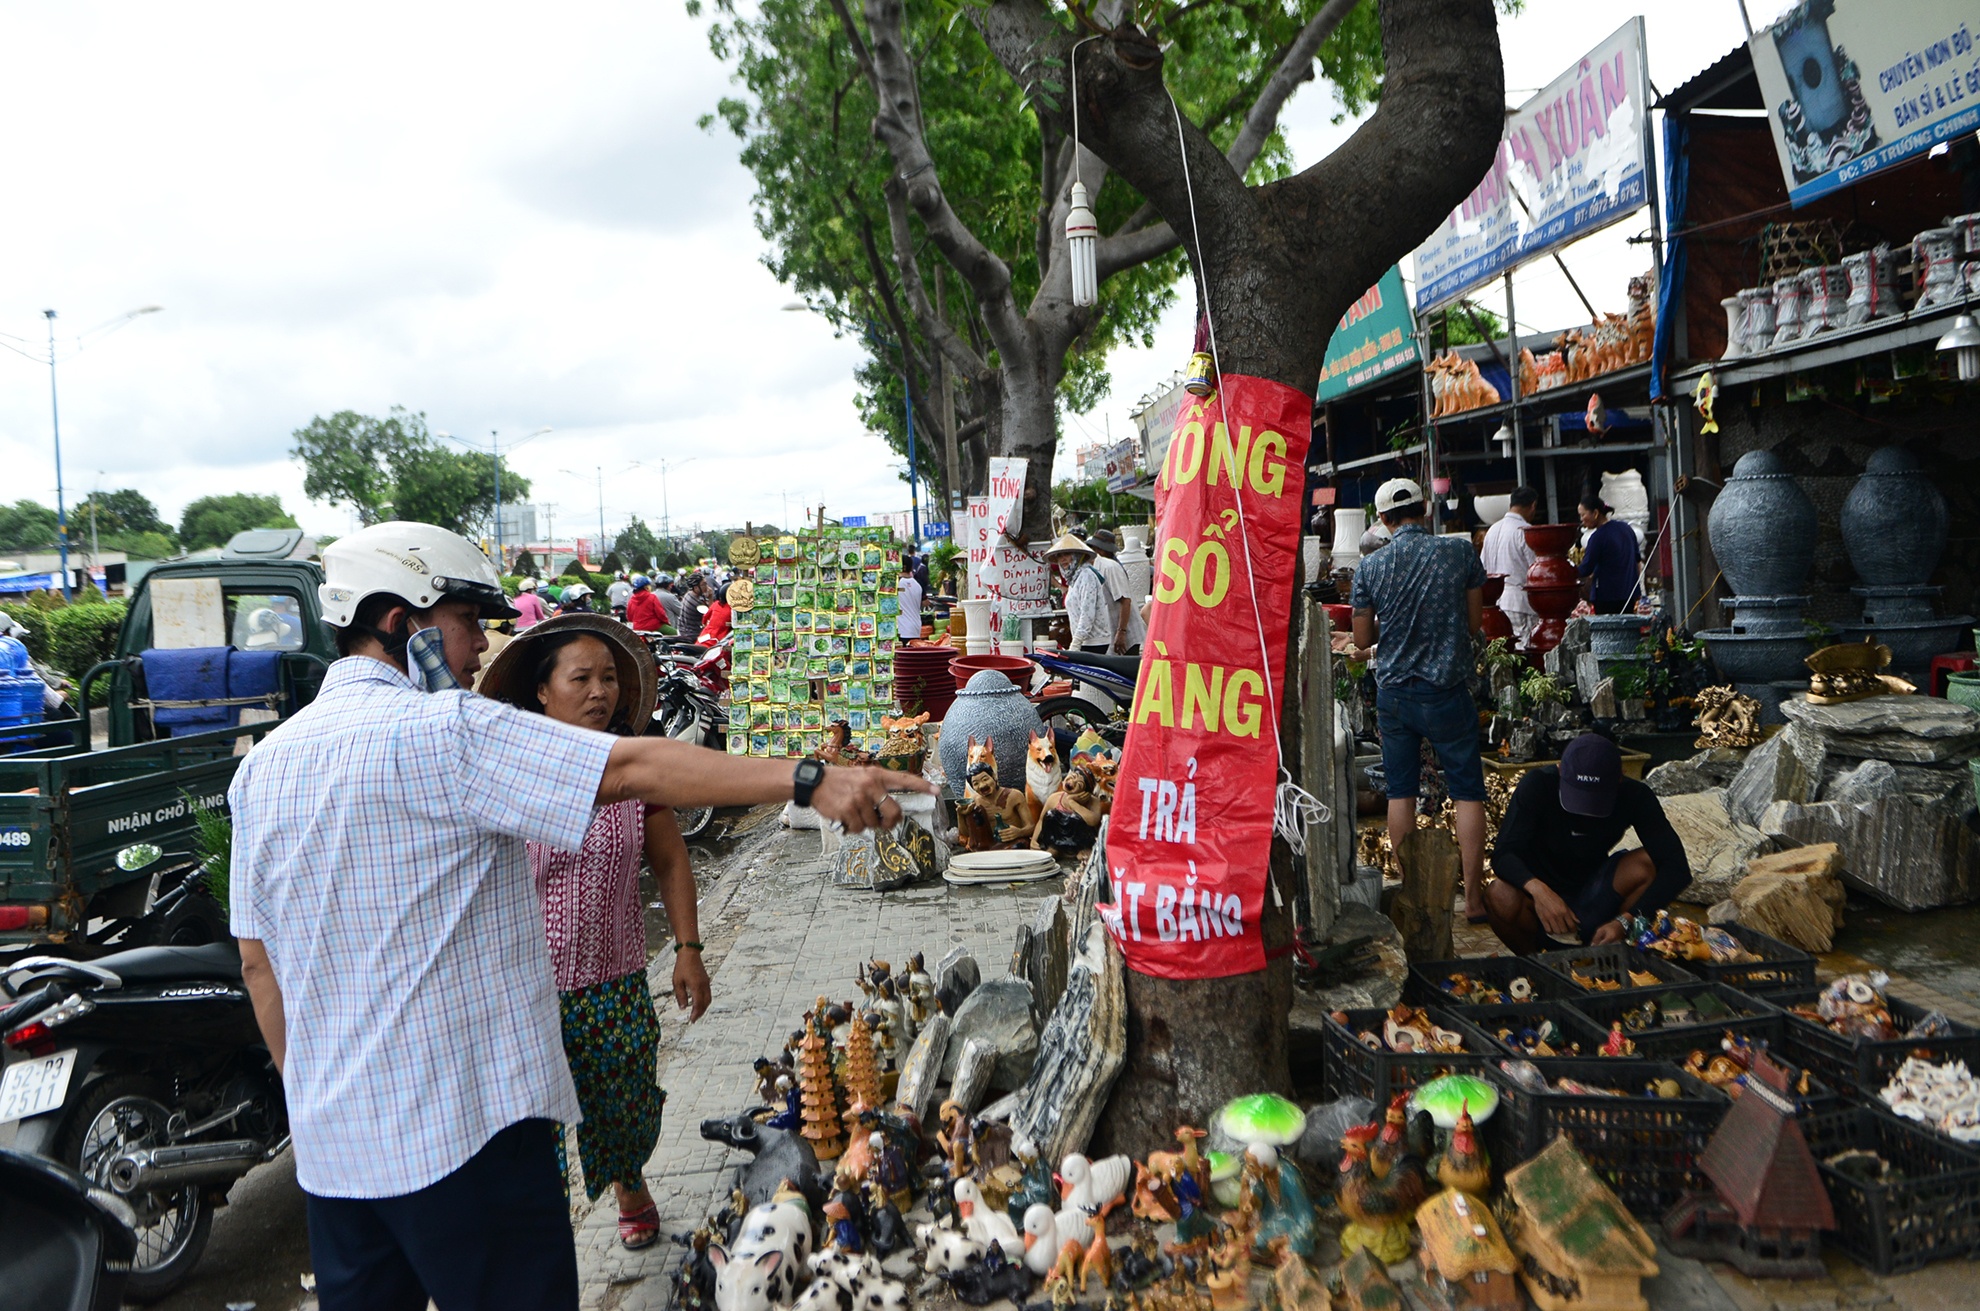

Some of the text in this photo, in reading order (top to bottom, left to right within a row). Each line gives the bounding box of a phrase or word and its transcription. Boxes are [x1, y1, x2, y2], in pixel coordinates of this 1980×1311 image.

[1861, 158, 1878, 173] 3B
[1933, 109, 1980, 139] CHINH
[1156, 509, 1239, 609] SỔ
[107, 811, 152, 834] NHẬN
[1139, 757, 1198, 845] TRẢ
[11, 1056, 64, 1091] 52-P3
[4, 1082, 55, 1118] 2511
